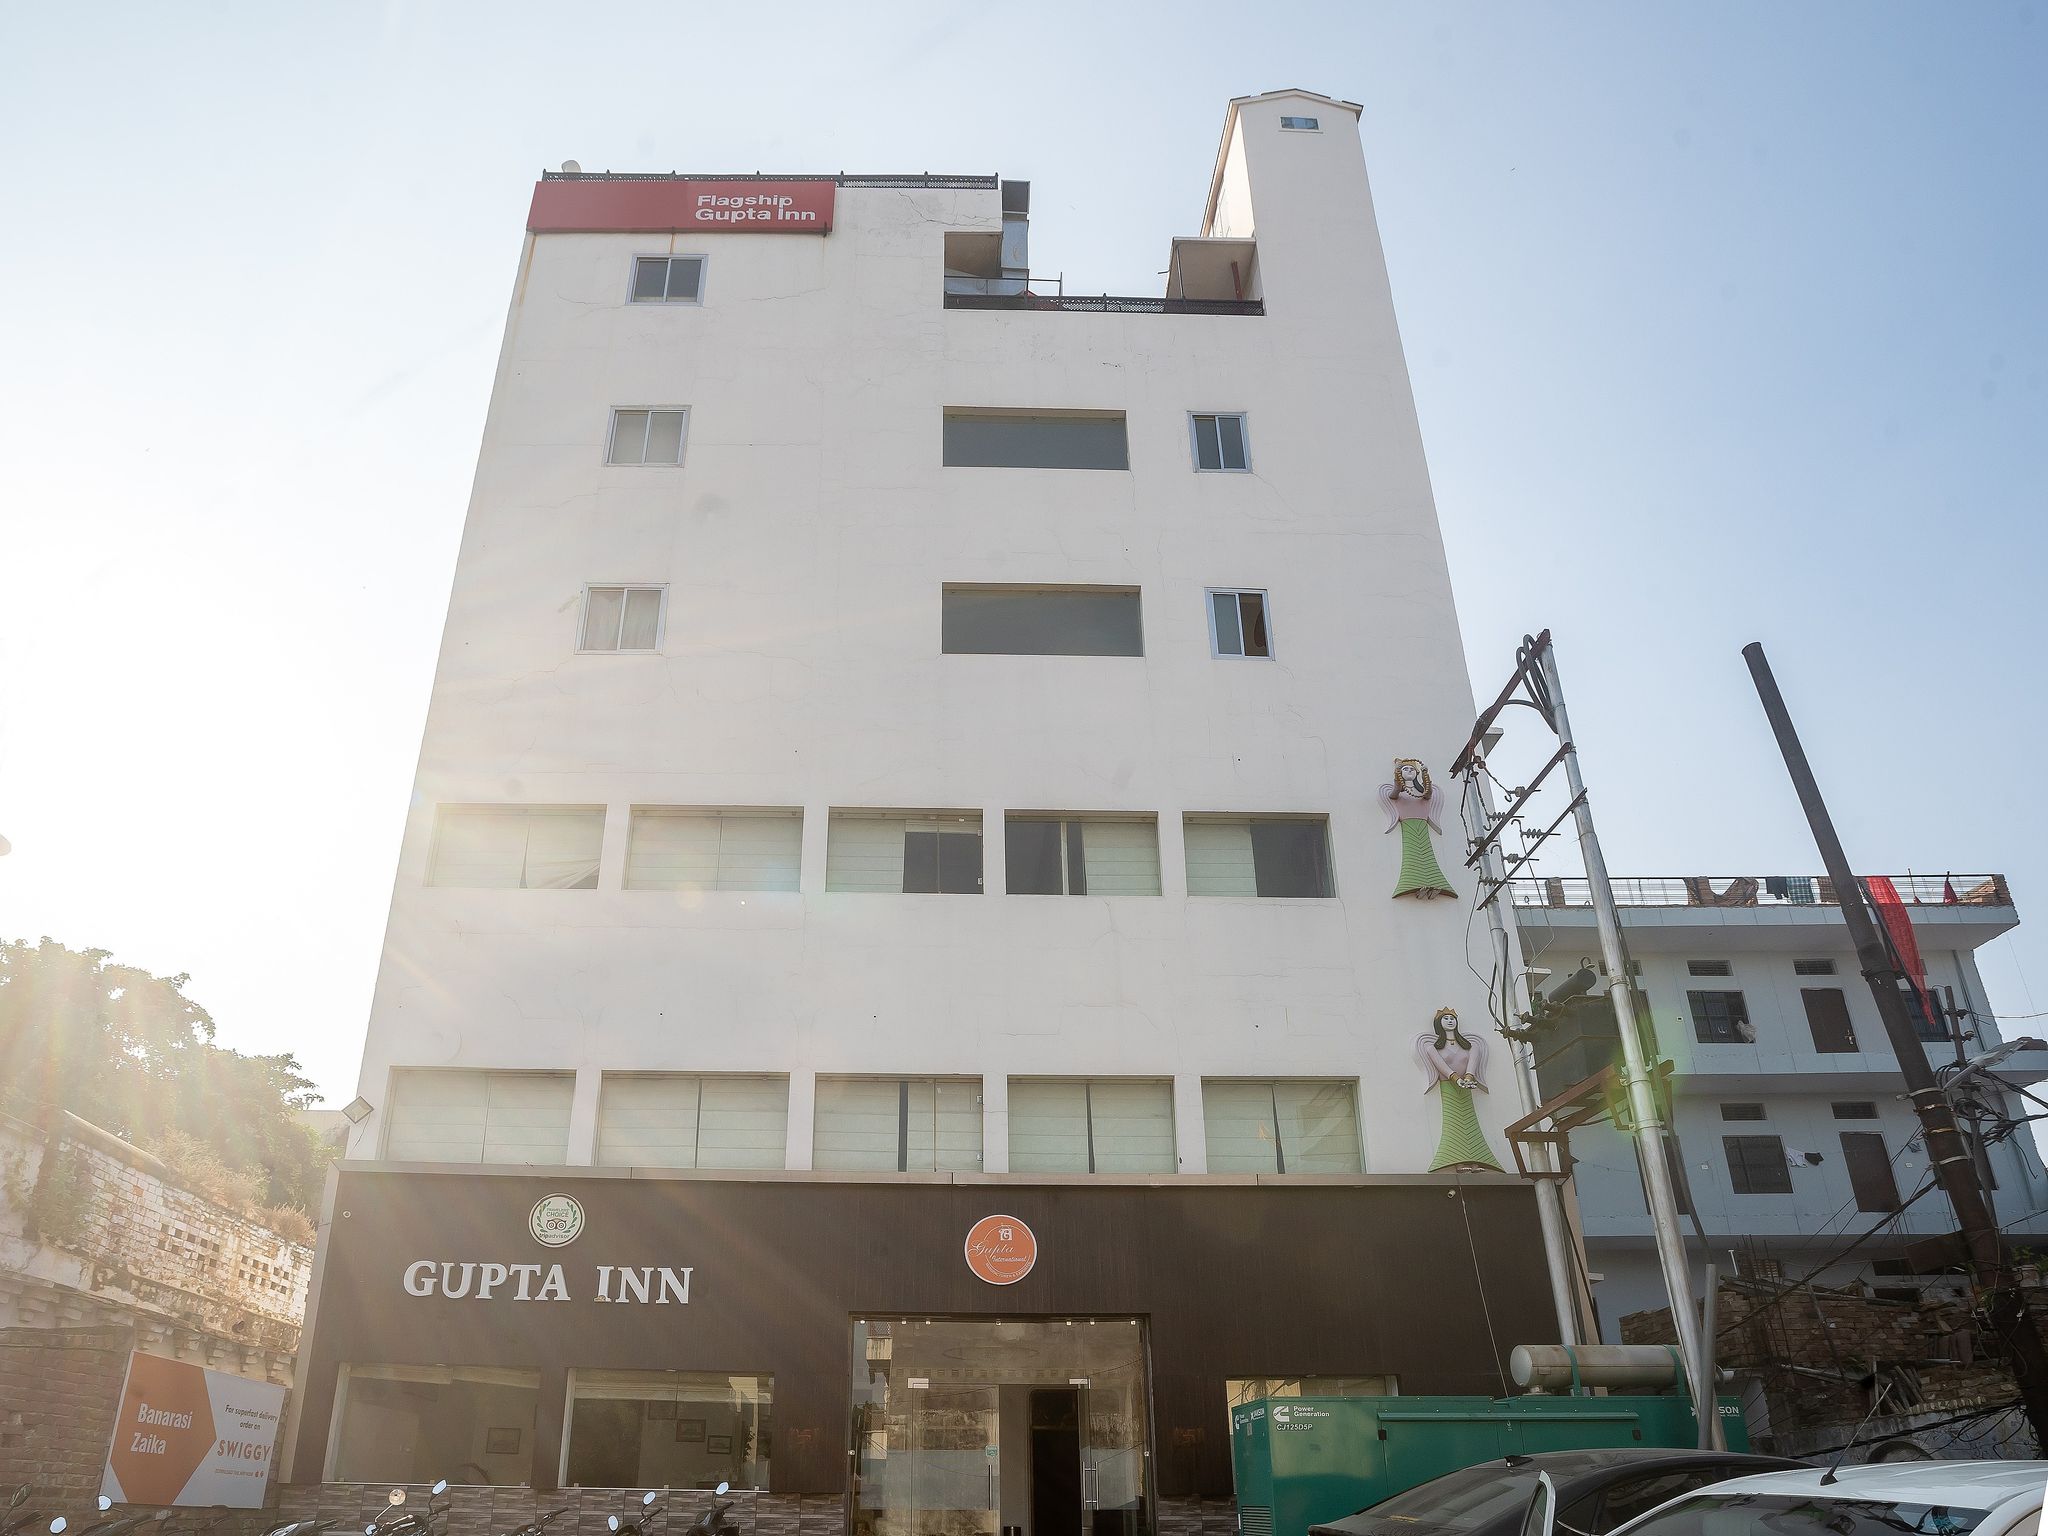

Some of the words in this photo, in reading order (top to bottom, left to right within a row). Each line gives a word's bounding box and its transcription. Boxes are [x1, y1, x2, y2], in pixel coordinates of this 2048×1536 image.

[697, 194, 793, 208] Flagship
[695, 207, 771, 223] Gupta
[778, 207, 816, 221] Inn
[968, 1241, 1015, 1259] Gupta
[403, 1260, 571, 1301] GUPTA
[594, 1265, 694, 1304] INN
[137, 1402, 193, 1429] Banarasi
[225, 1404, 234, 1413] For
[239, 1420, 253, 1429] order
[1276, 1423, 1313, 1431] CJ125D5P
[130, 1432, 167, 1455] Zaika
[217, 1439, 271, 1461] SWIGGY
